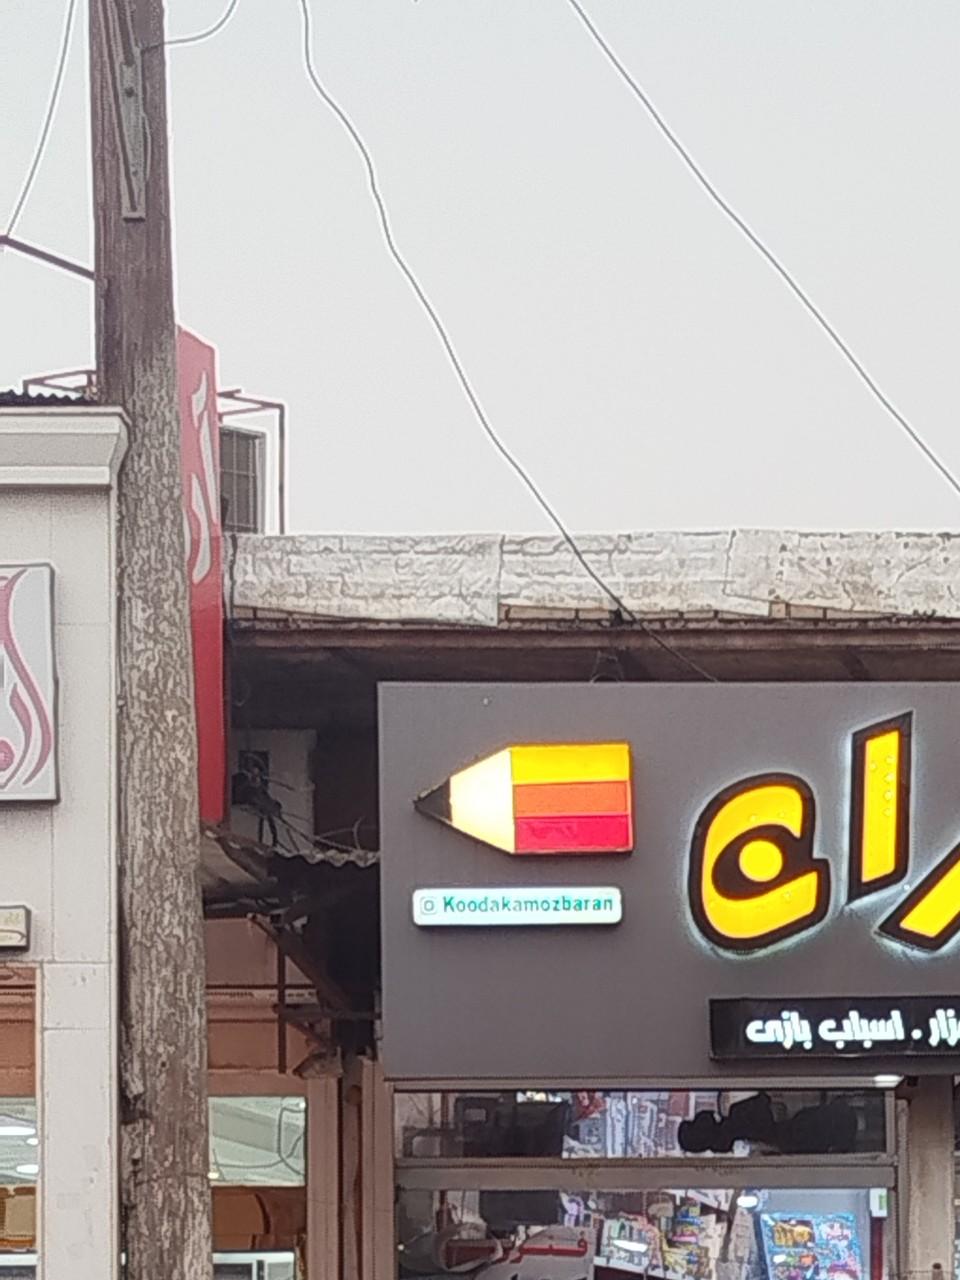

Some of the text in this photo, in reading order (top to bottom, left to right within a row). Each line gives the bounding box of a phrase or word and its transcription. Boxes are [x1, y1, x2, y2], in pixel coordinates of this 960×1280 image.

[443, 896, 614, 913] Koodakamozbaran
[745, 1010, 813, 1050] بازی
[818, 1009, 905, 1049] اسباب
